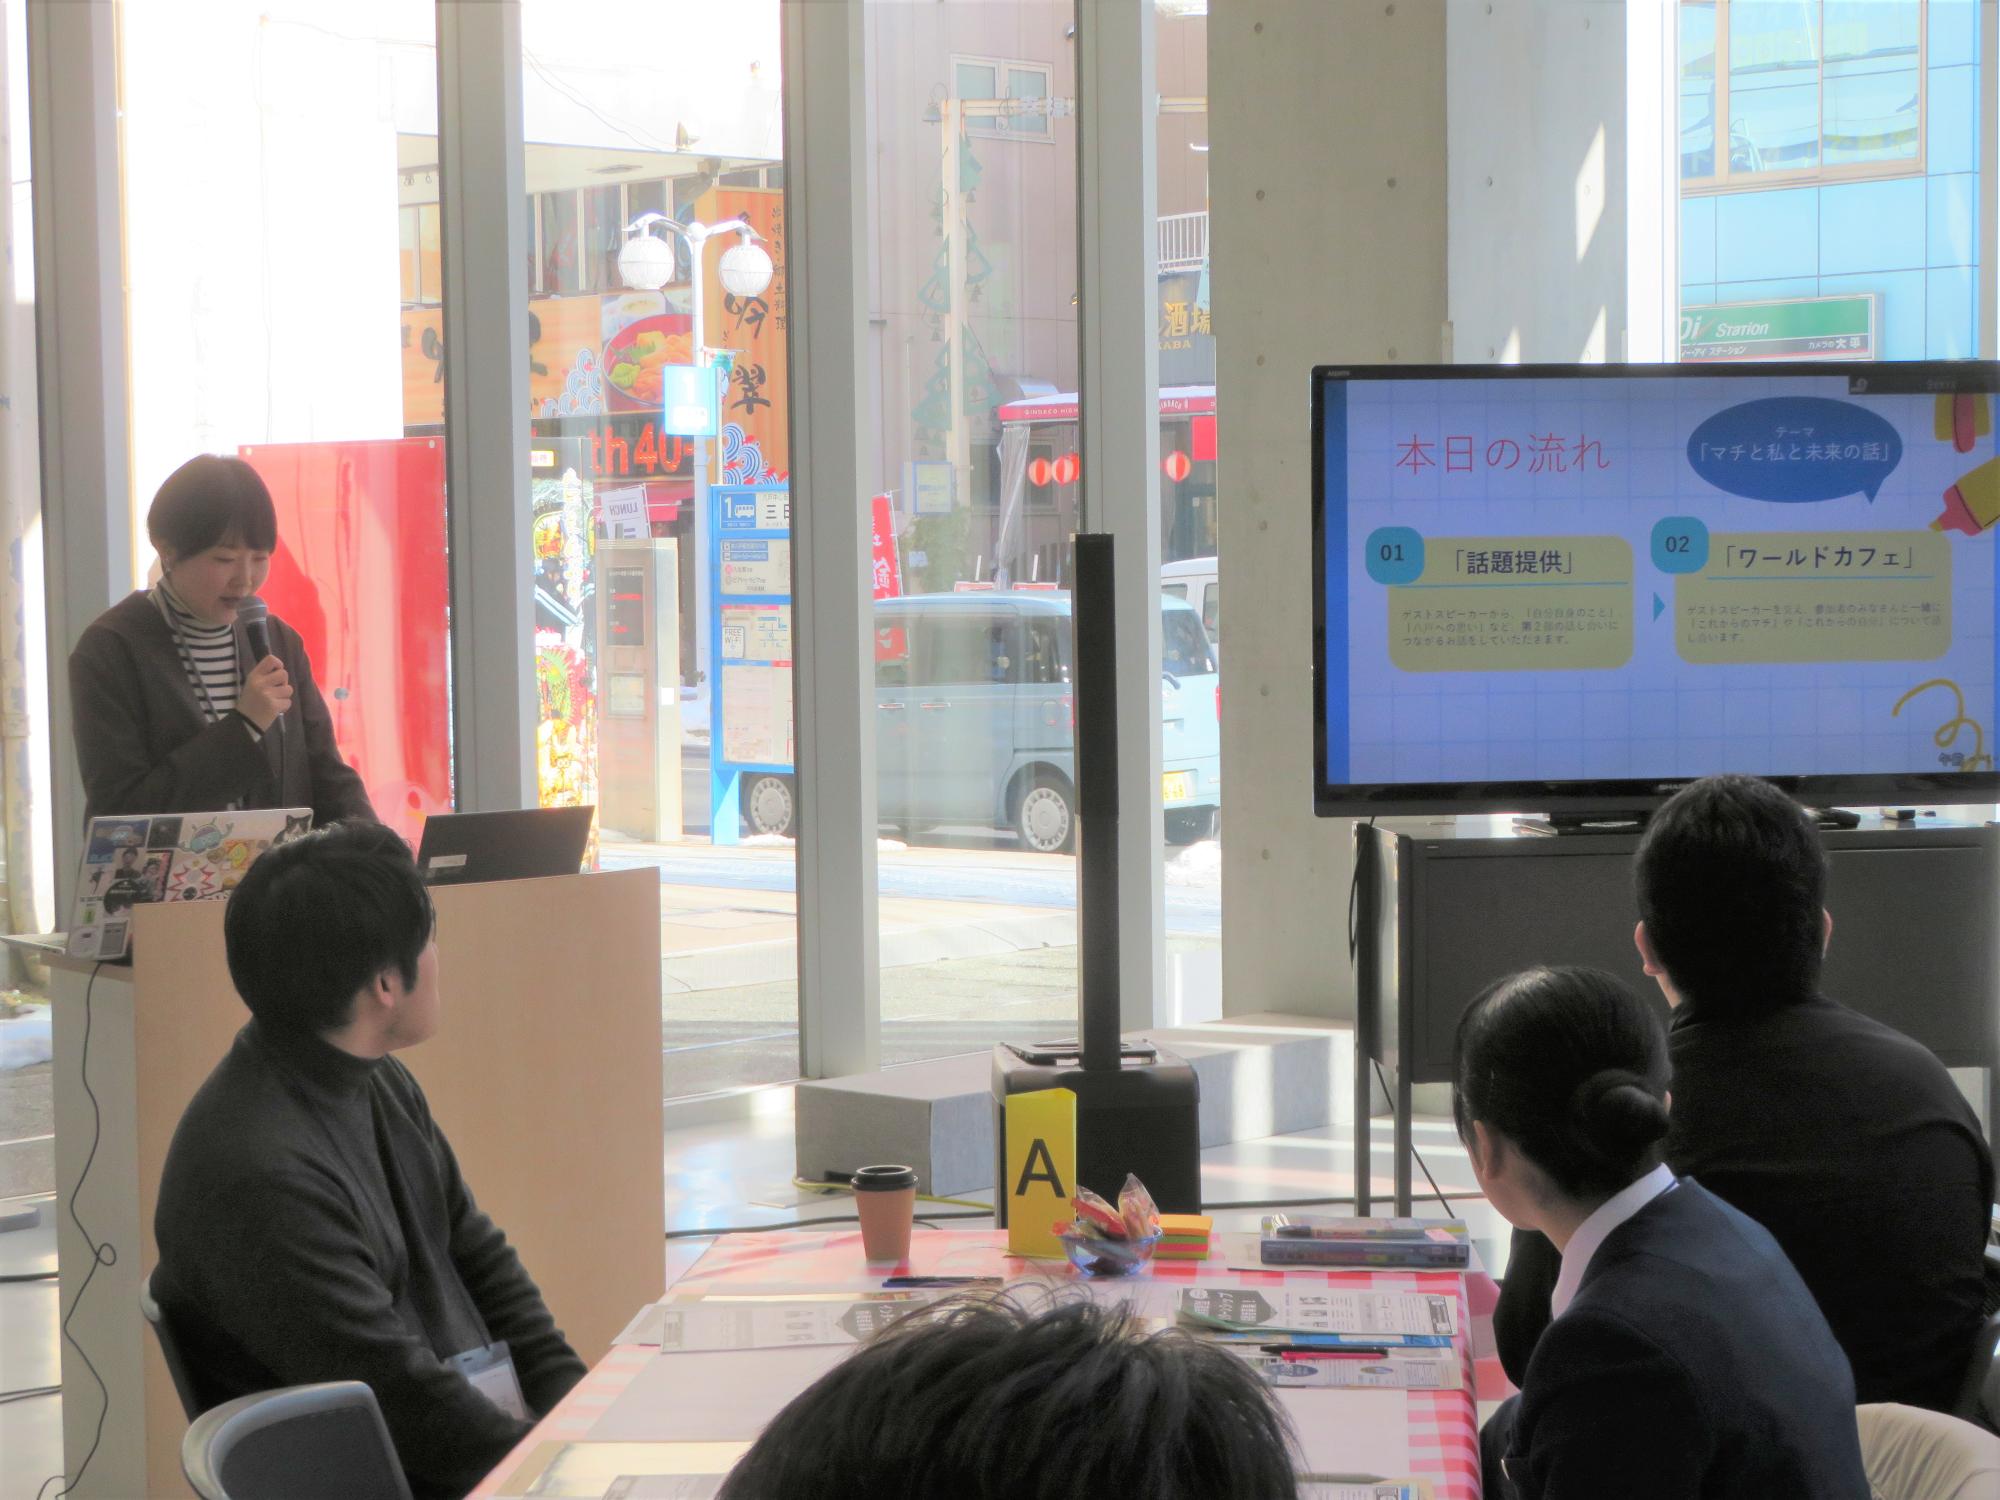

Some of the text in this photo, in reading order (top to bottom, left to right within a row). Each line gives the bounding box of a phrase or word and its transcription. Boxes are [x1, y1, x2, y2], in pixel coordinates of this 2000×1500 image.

[1715, 320, 1769, 338] Station
[1775, 425, 1815, 439] テーマ
[1395, 432, 1612, 475] 本日の流れ
[1699, 441, 1889, 463] 「マチと私と未来の話」
[724, 495, 732, 519] 1
[1380, 544, 1405, 562] 01
[1664, 535, 1690, 554] 02
[1455, 549, 1574, 576] 「話題提供」
[1726, 545, 1913, 570] 「ワールドカフェ」
[1015, 1137, 1066, 1198] A
